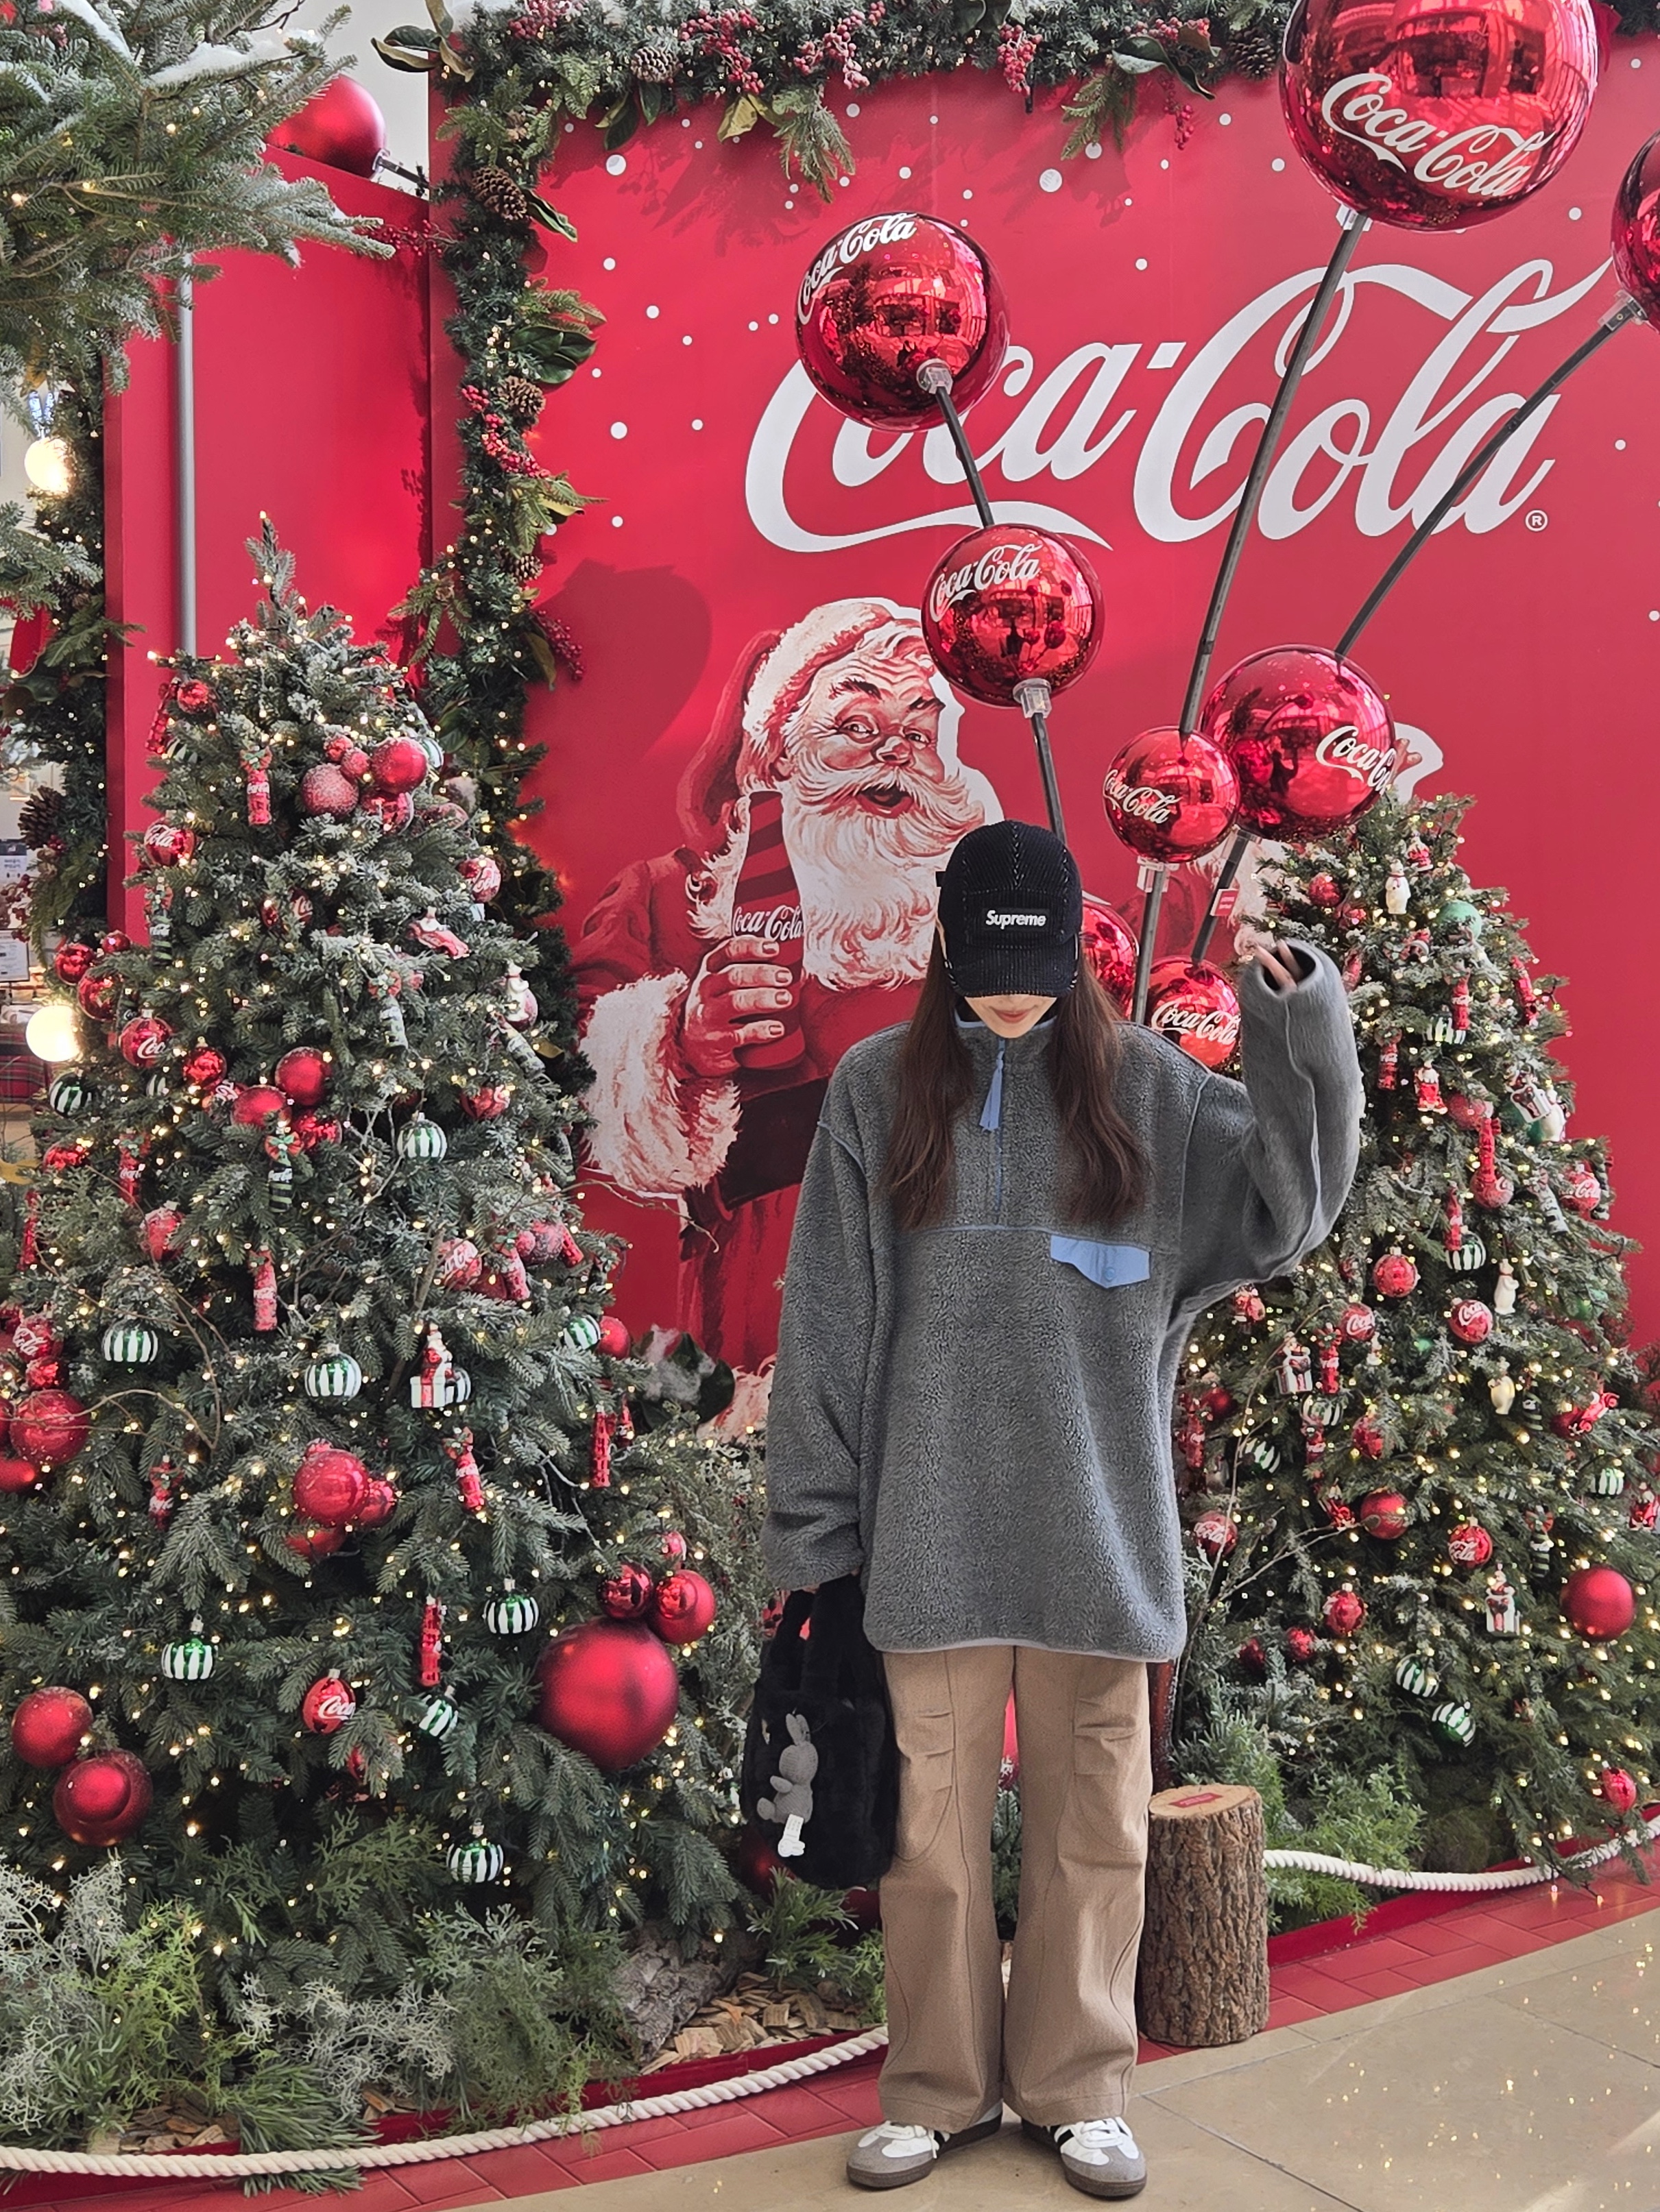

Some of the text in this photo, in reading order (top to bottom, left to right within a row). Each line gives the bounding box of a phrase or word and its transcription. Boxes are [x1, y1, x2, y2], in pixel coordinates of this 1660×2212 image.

[1322, 73, 1555, 197] Coca-Cola
[798, 212, 917, 325] Coca-Cola
[930, 544, 1043, 622] Coca-Cola
[1315, 725, 1397, 797] Coca-Co
[1103, 769, 1183, 824] Coca-Cola
[733, 905, 804, 941] Coca-Cola
[985, 910, 1046, 929] Supreme
[1151, 1000, 1241, 1045] Coca-Cola
